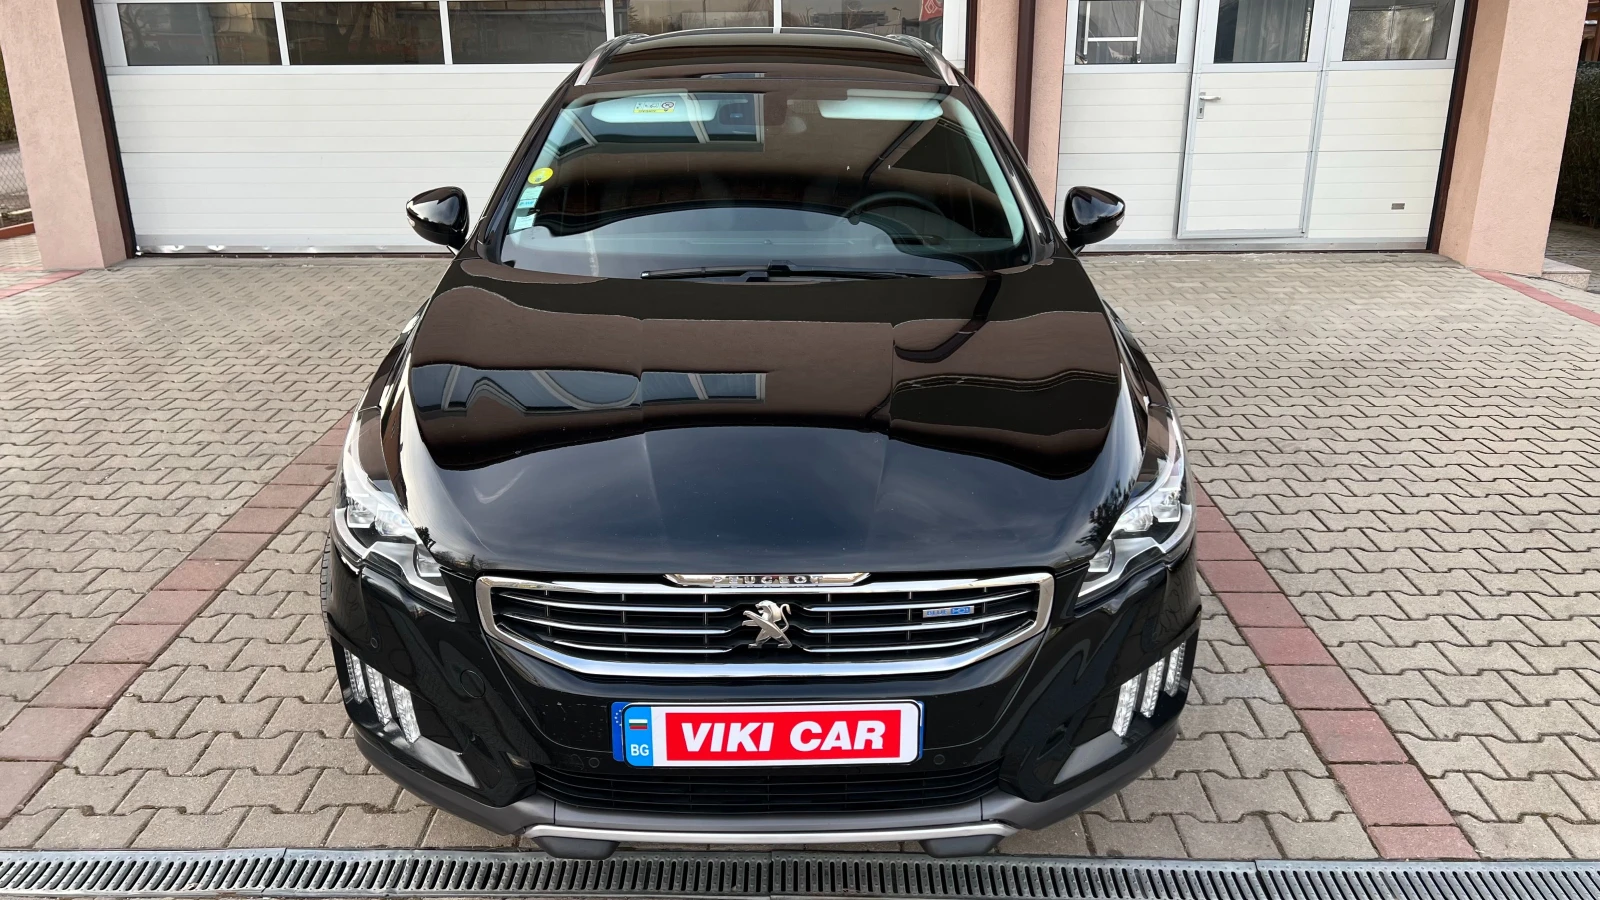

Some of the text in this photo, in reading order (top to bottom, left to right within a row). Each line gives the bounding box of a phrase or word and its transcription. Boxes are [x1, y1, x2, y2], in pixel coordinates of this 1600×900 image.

[711, 575, 823, 586] PEUGEOT
[681, 720, 886, 753] VIKI CAR
[630, 743, 650, 757] BG
